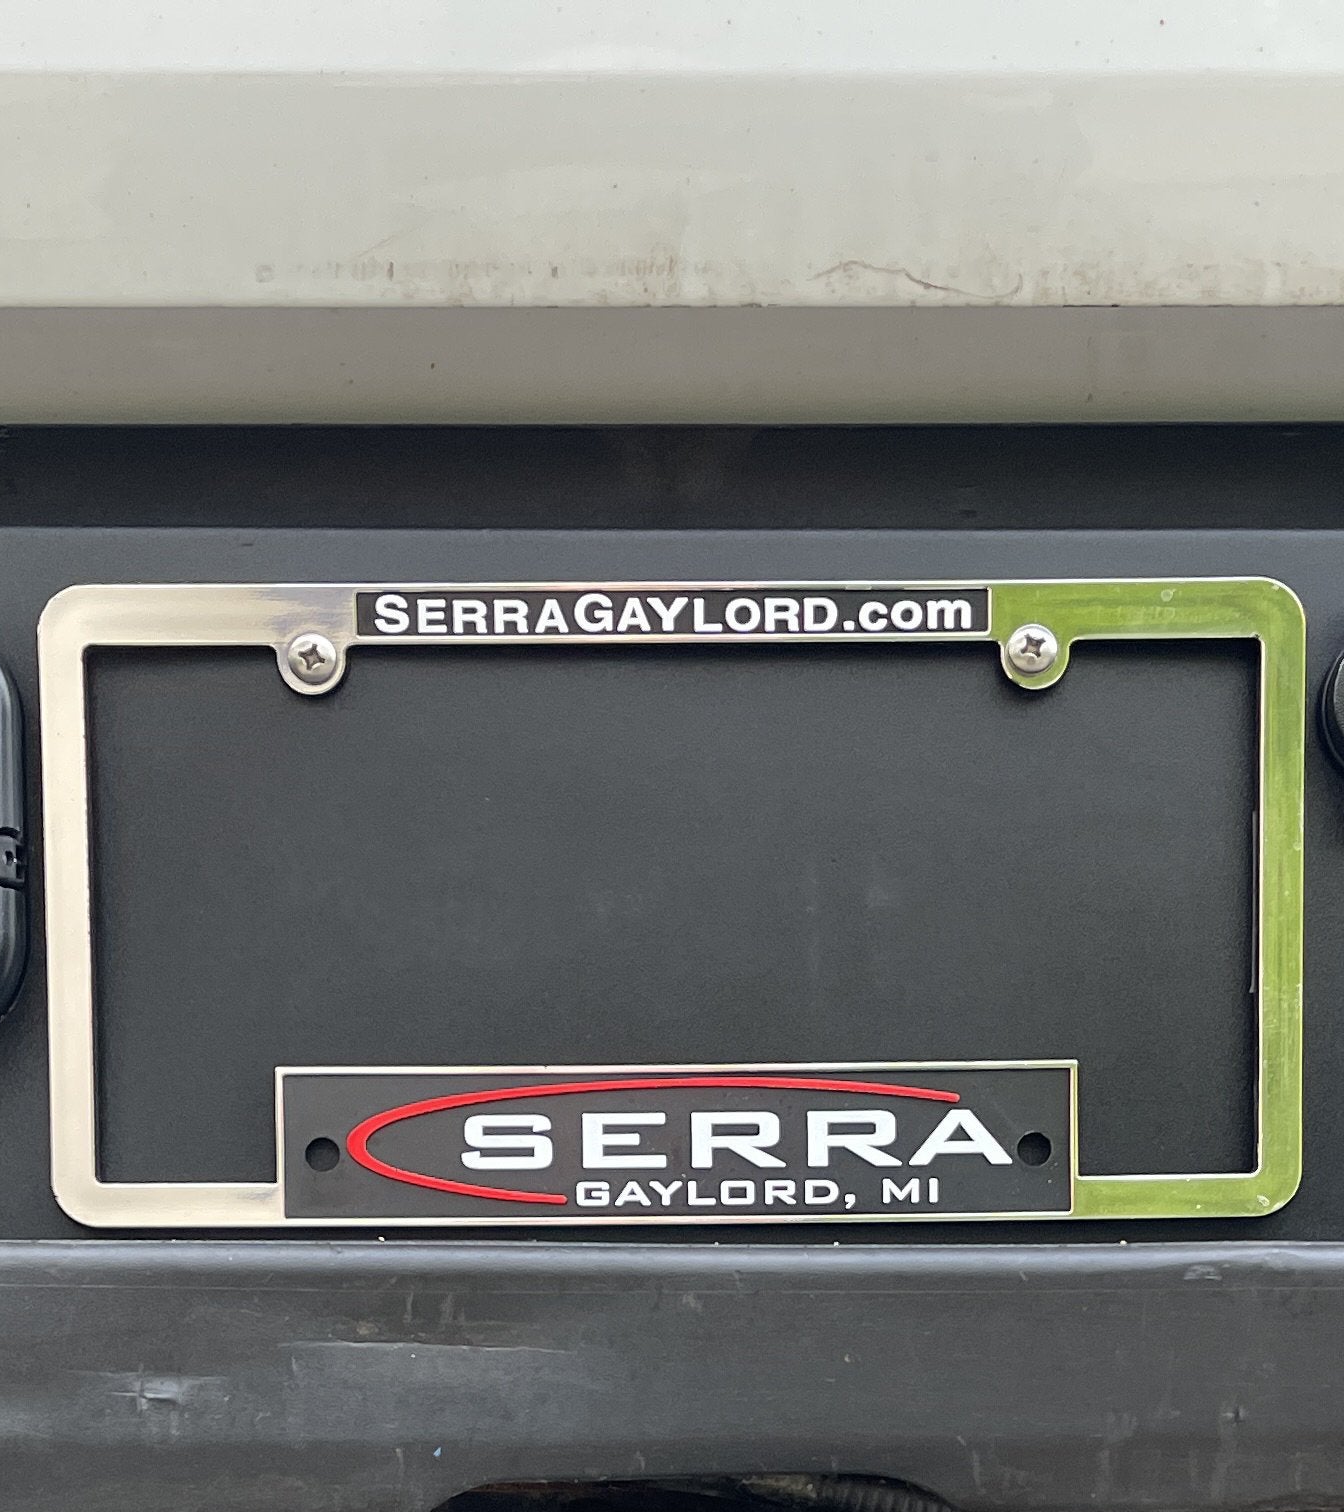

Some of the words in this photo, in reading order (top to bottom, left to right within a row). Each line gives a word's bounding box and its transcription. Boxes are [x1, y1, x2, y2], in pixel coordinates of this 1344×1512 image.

[374, 592, 973, 635] SERRAGAYLORD.com
[460, 1108, 1014, 1171] SERRA
[574, 1179, 856, 1210] GAYLORD,
[882, 1177, 940, 1204] MI
